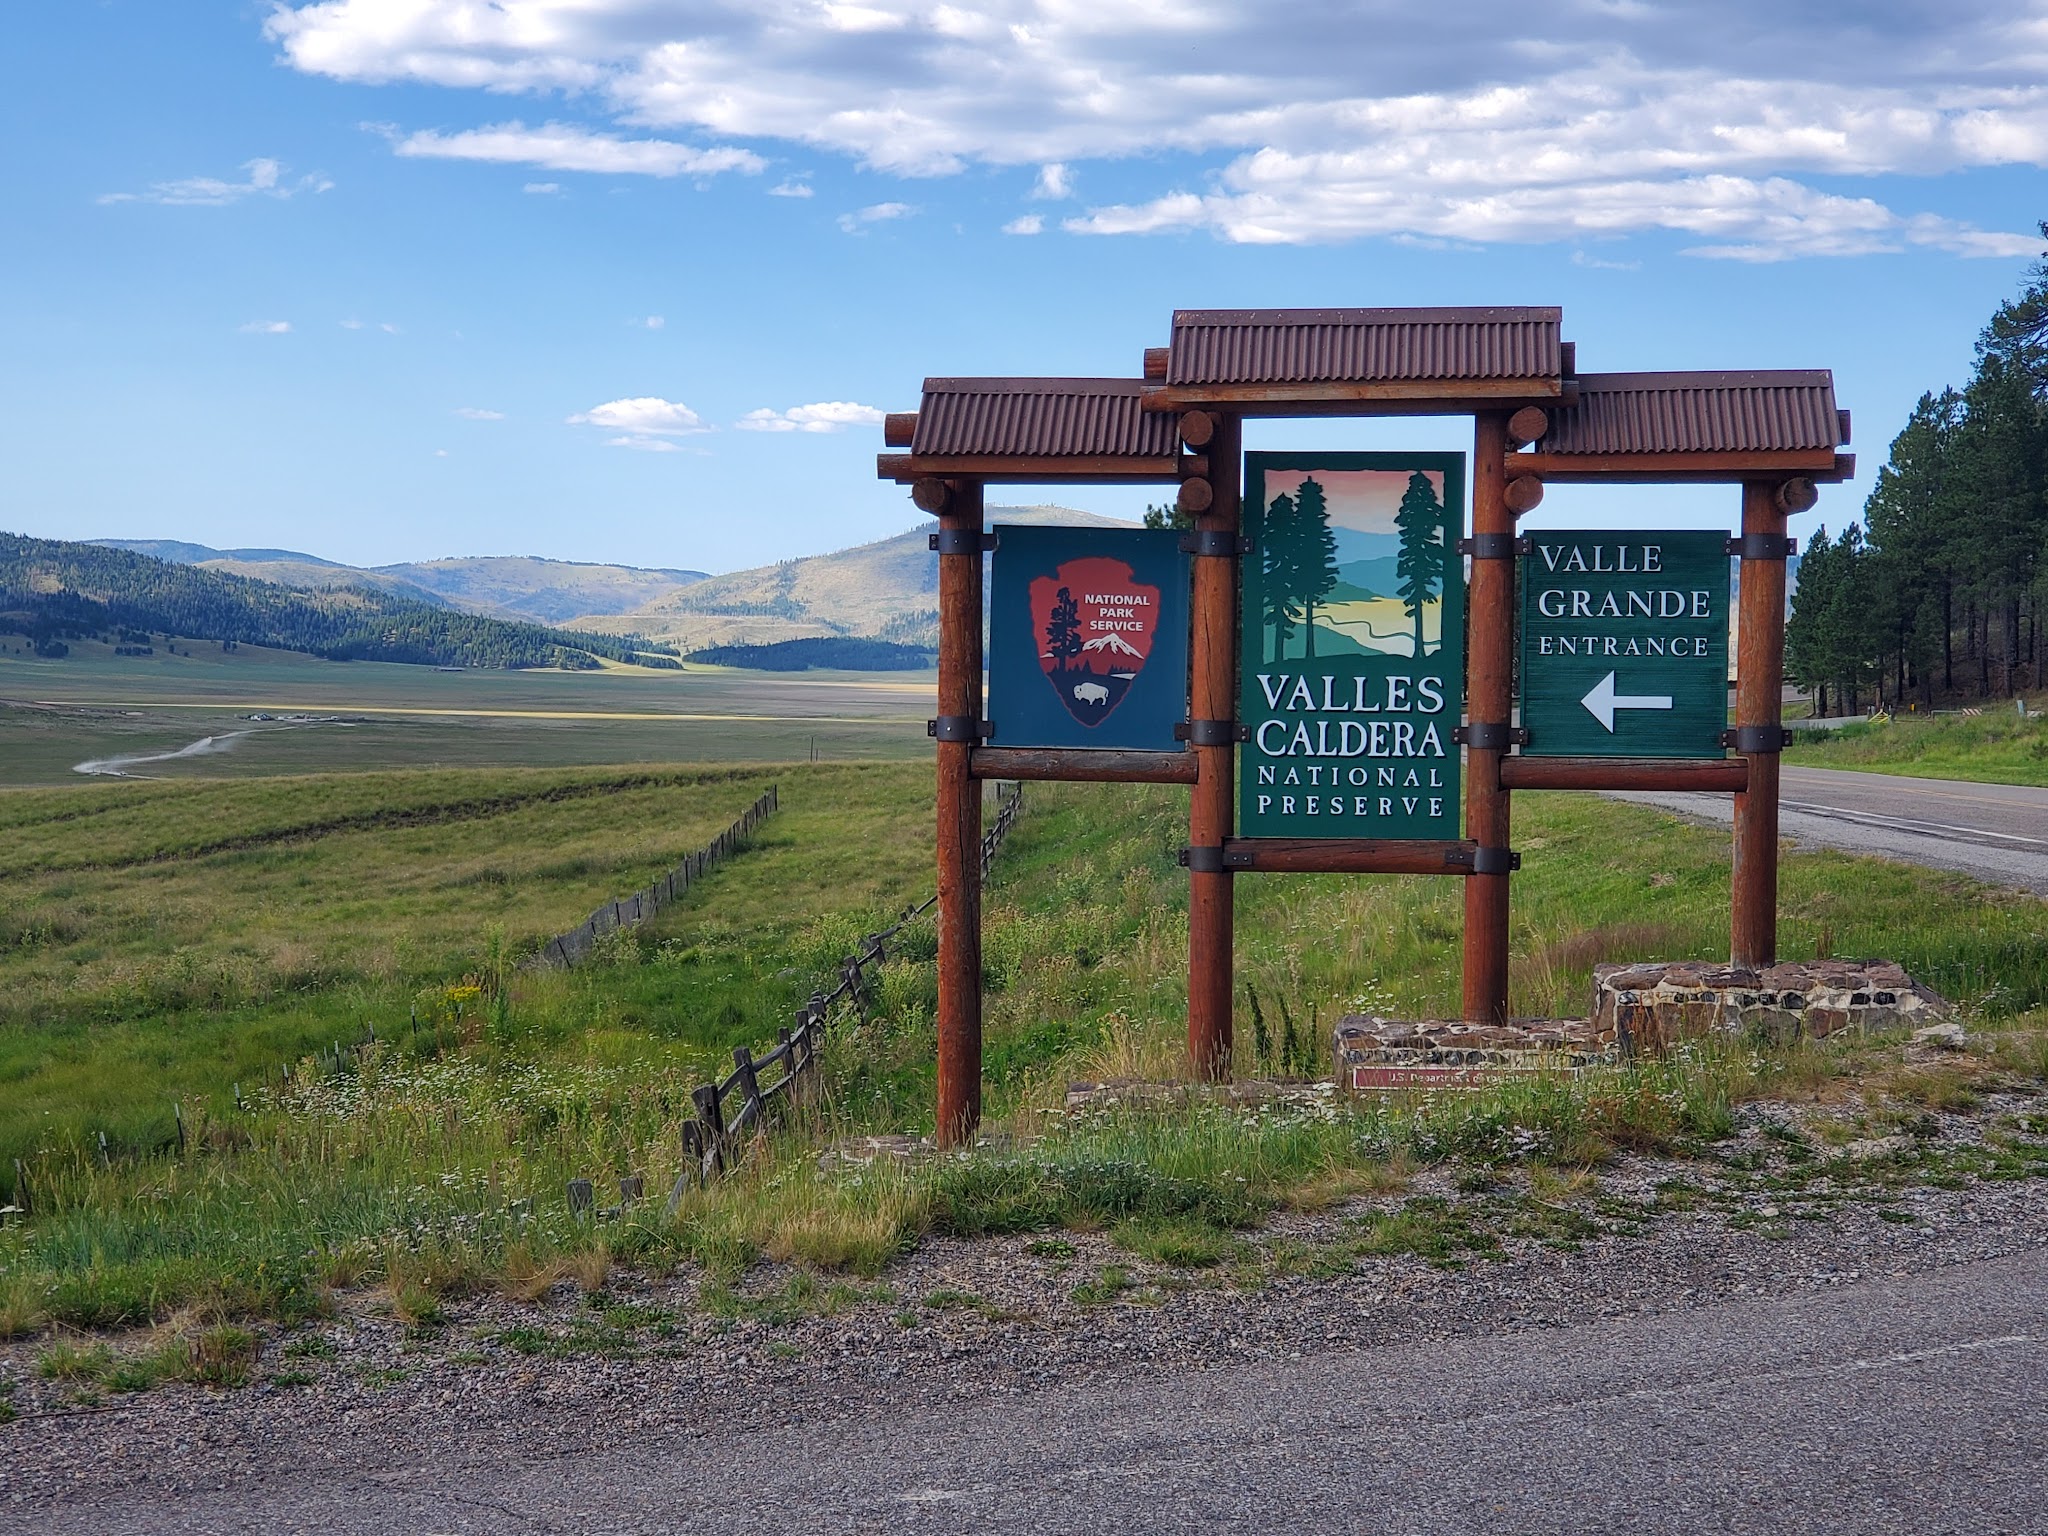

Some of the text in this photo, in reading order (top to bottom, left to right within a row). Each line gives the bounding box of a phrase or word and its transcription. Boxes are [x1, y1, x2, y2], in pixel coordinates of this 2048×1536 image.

[1538, 545, 1662, 572] VALLE
[1085, 594, 1150, 606] NATIONAL
[1538, 589, 1710, 618] GRANDE
[1100, 608, 1134, 618] PARK
[1090, 621, 1143, 632] SERVICE
[1539, 636, 1708, 657] ENTRANCE
[1256, 674, 1444, 713] VALLES
[1256, 719, 1445, 757] CALDERA
[1257, 765, 1443, 787] NATIONAL
[1257, 795, 1443, 817] PRESERVE
